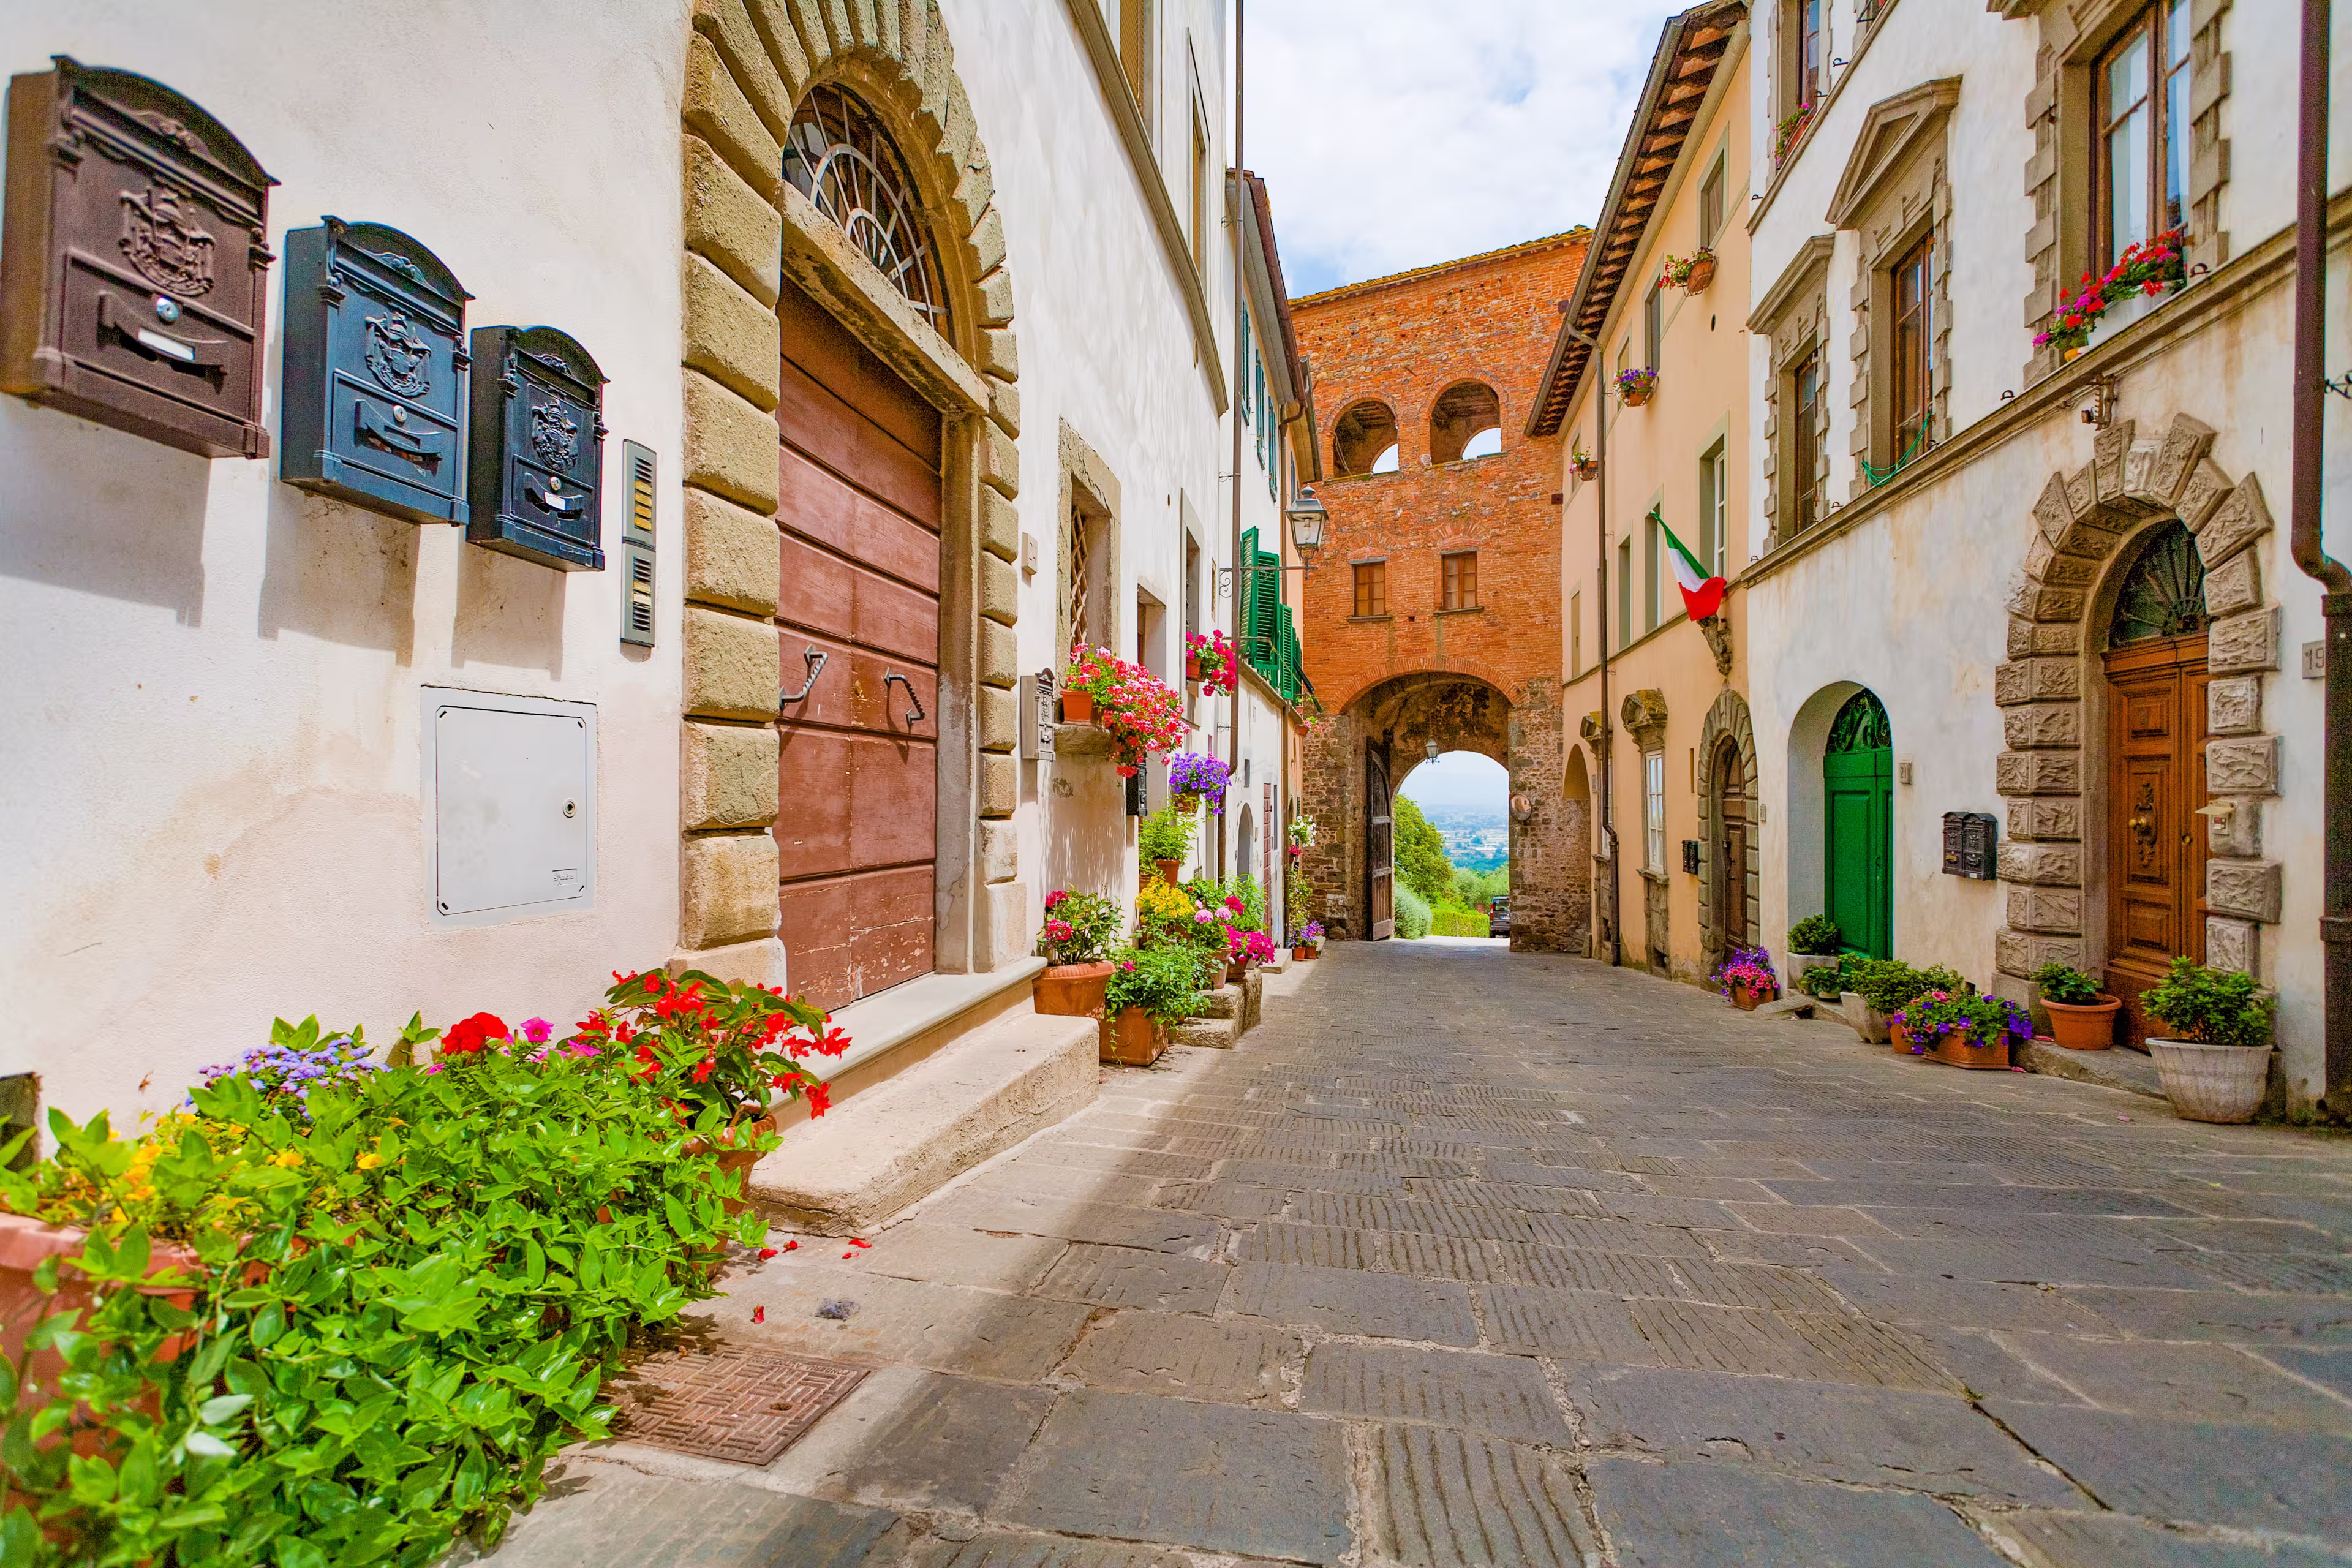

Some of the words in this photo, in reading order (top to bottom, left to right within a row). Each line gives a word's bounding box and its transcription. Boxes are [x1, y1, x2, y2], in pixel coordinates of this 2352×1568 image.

[2305, 647, 2325, 670] 19
[1900, 766, 1906, 778] 21
[806, 1365, 850, 1376] FONDERIA
